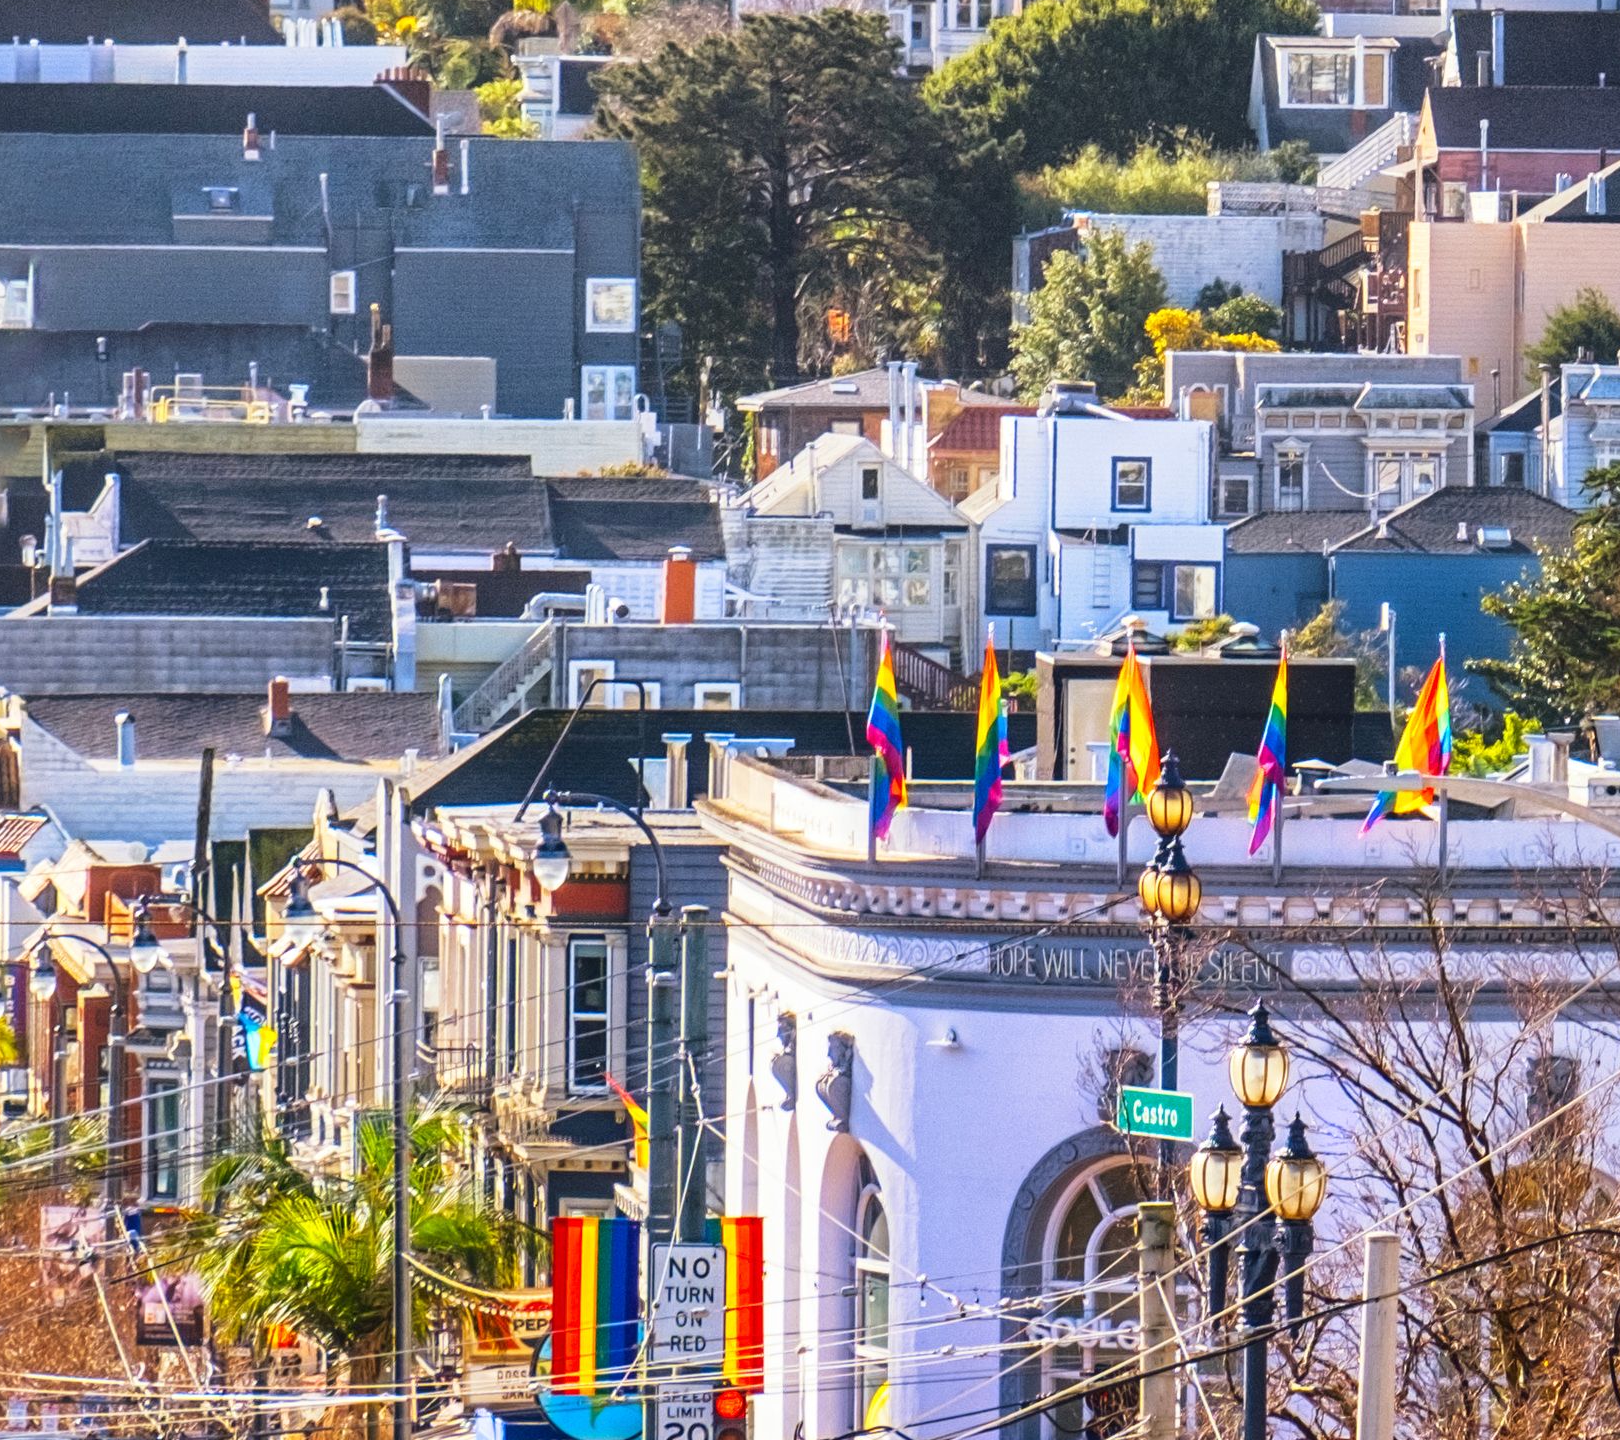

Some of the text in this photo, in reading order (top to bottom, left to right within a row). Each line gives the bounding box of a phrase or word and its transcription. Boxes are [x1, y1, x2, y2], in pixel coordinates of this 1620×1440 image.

[989, 945, 1036, 978] HOPE
[1042, 947, 1091, 981] WILL
[1132, 1099, 1178, 1128] Castro
[669, 1257, 711, 1279] NO
[665, 1286, 715, 1304] TURN
[675, 1311, 702, 1328] ON
[670, 1336, 707, 1352] RED
[662, 1390, 712, 1403] SPEED
[667, 1406, 706, 1419] LIMIT
